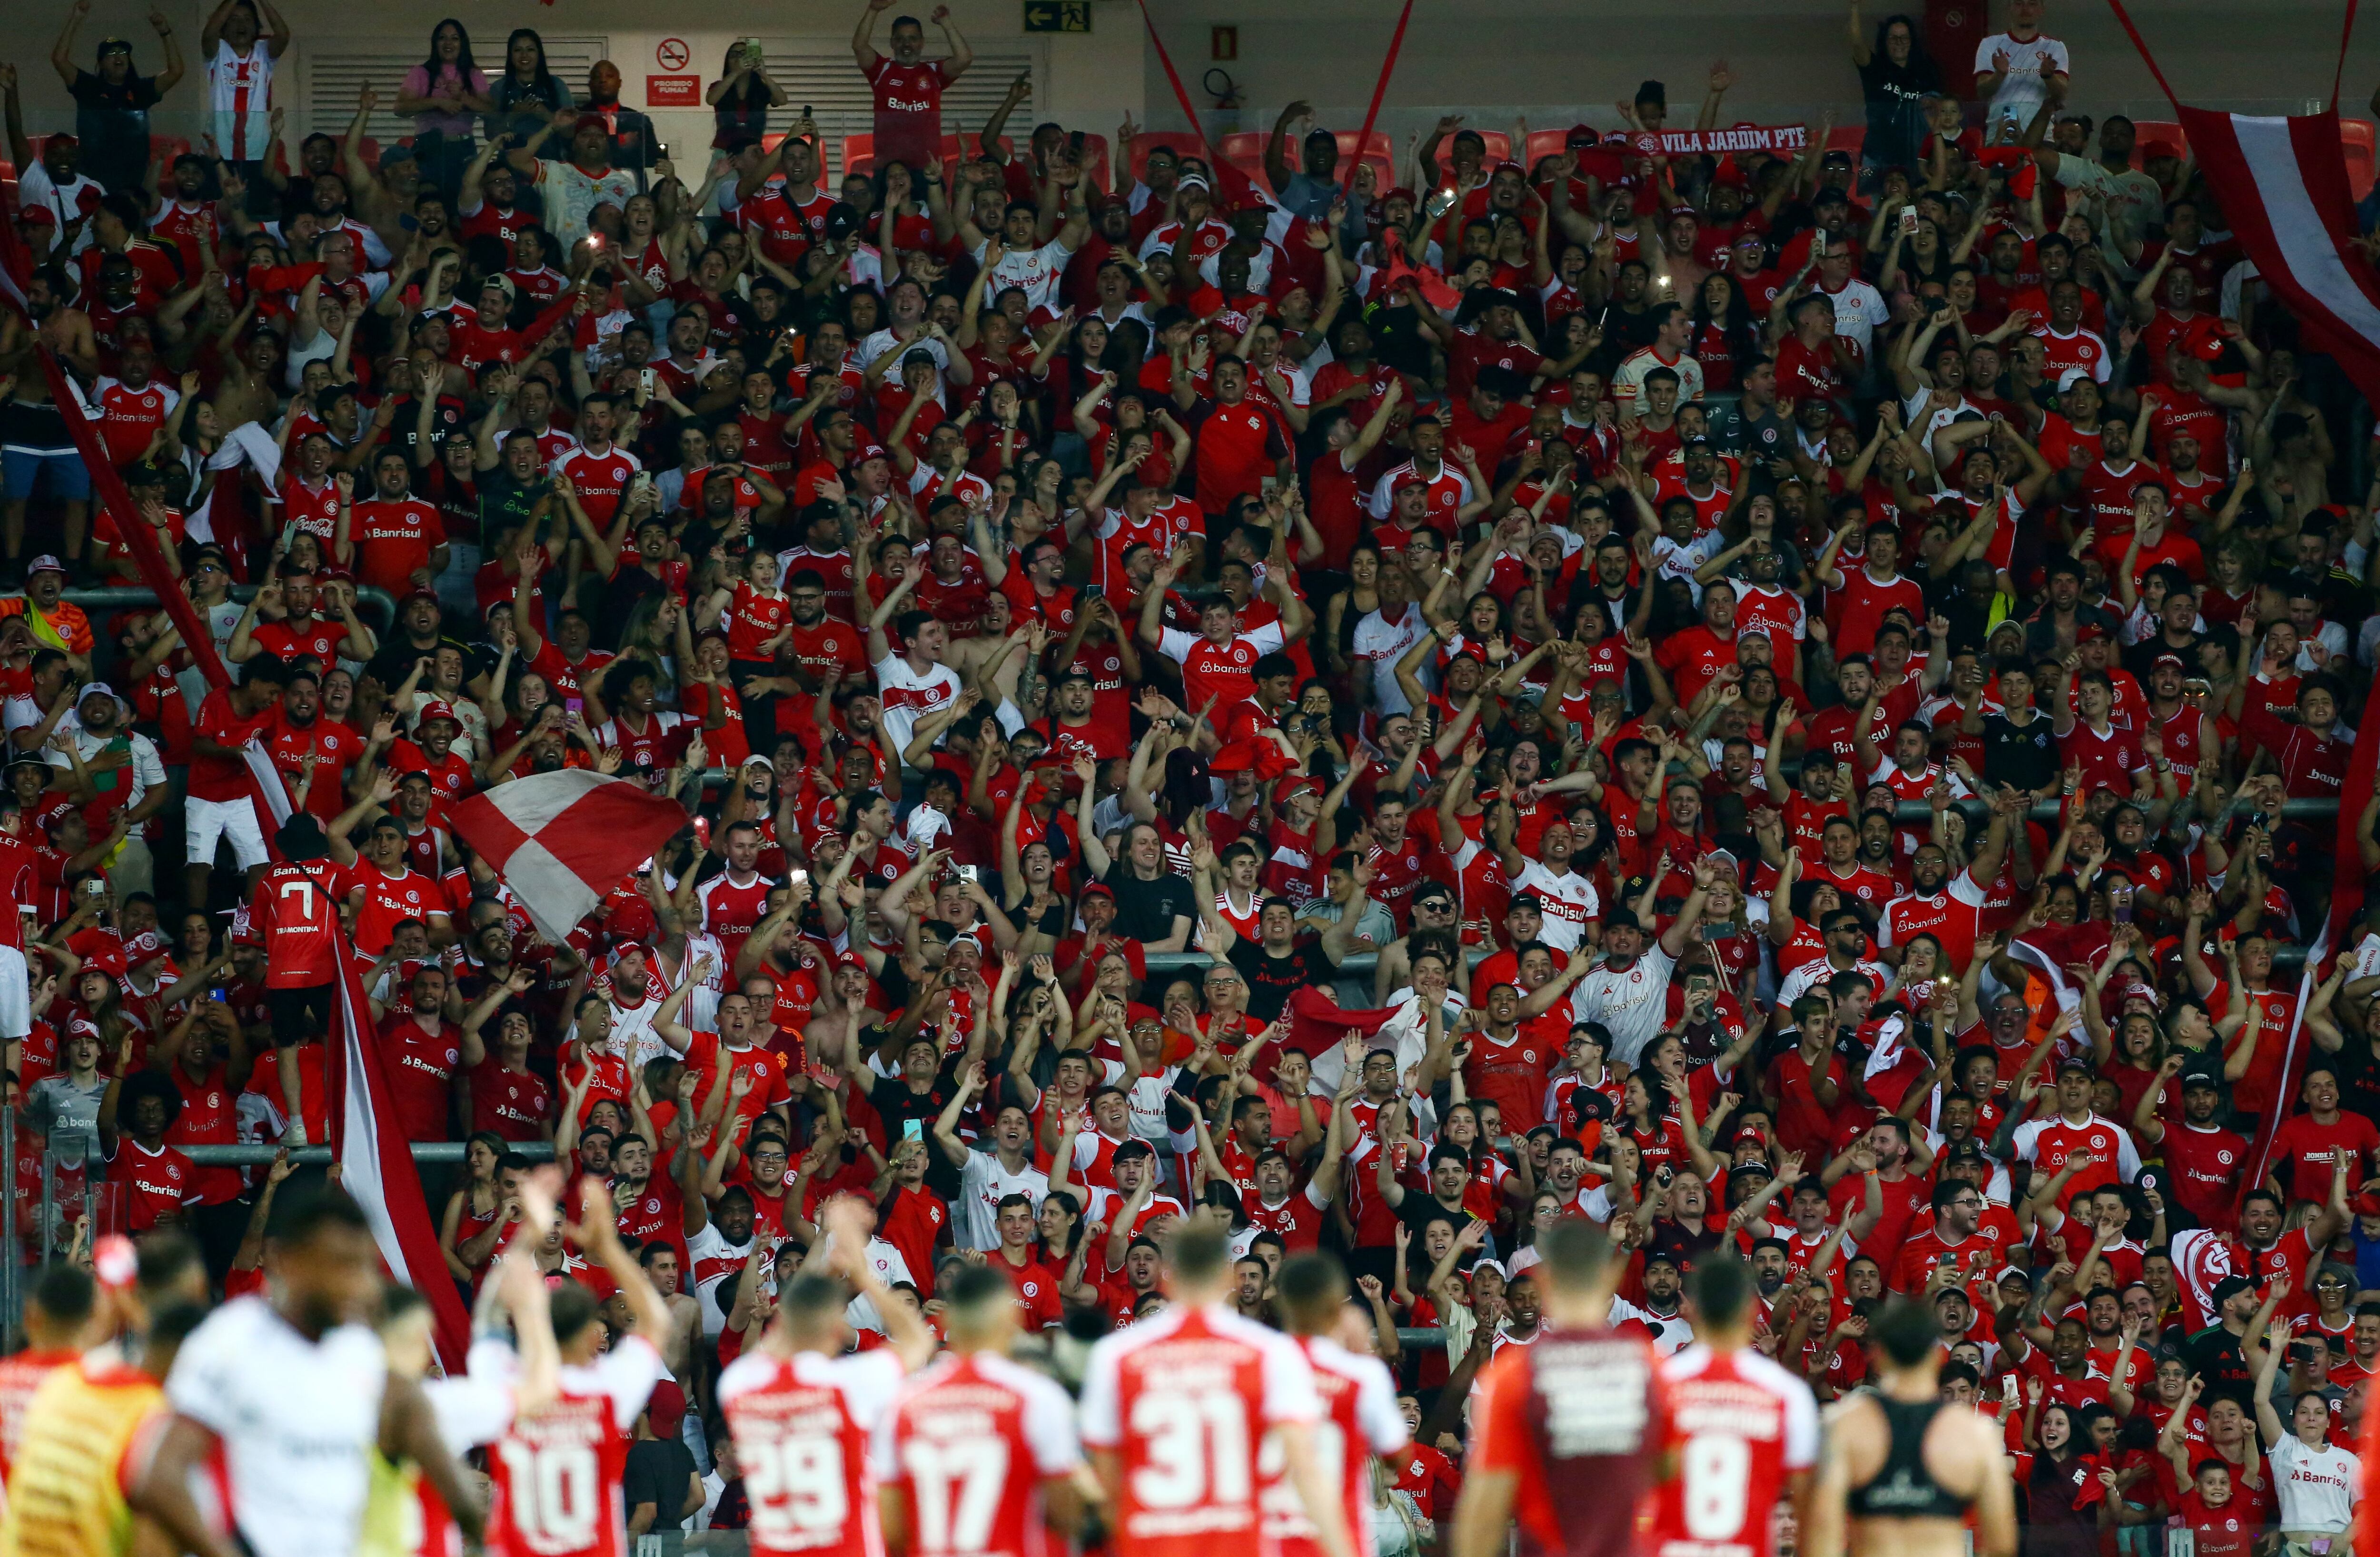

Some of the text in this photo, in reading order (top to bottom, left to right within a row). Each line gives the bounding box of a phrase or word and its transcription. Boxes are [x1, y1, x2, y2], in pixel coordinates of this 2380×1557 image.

[1661, 127, 1806, 152] VILA JARDIM PTE
[116, 413, 156, 423] banrisul
[373, 528, 421, 538] Banrisul
[1370, 631, 1413, 662] Banrisul
[281, 882, 312, 920] 7
[276, 925, 319, 935] TRAMONTINA
[1909, 912, 1947, 929] banrisul
[1613, 993, 1649, 1012] banrisul
[142, 1180, 182, 1199] Banrisul
[1131, 1391, 1247, 1509] 31
[503, 1437, 599, 1546] 10
[761, 1434, 849, 1526] 29
[904, 1433, 1009, 1550] 17
[1682, 1431, 1755, 1541] 8
[2211, 1542, 2239, 1552] banrisul
